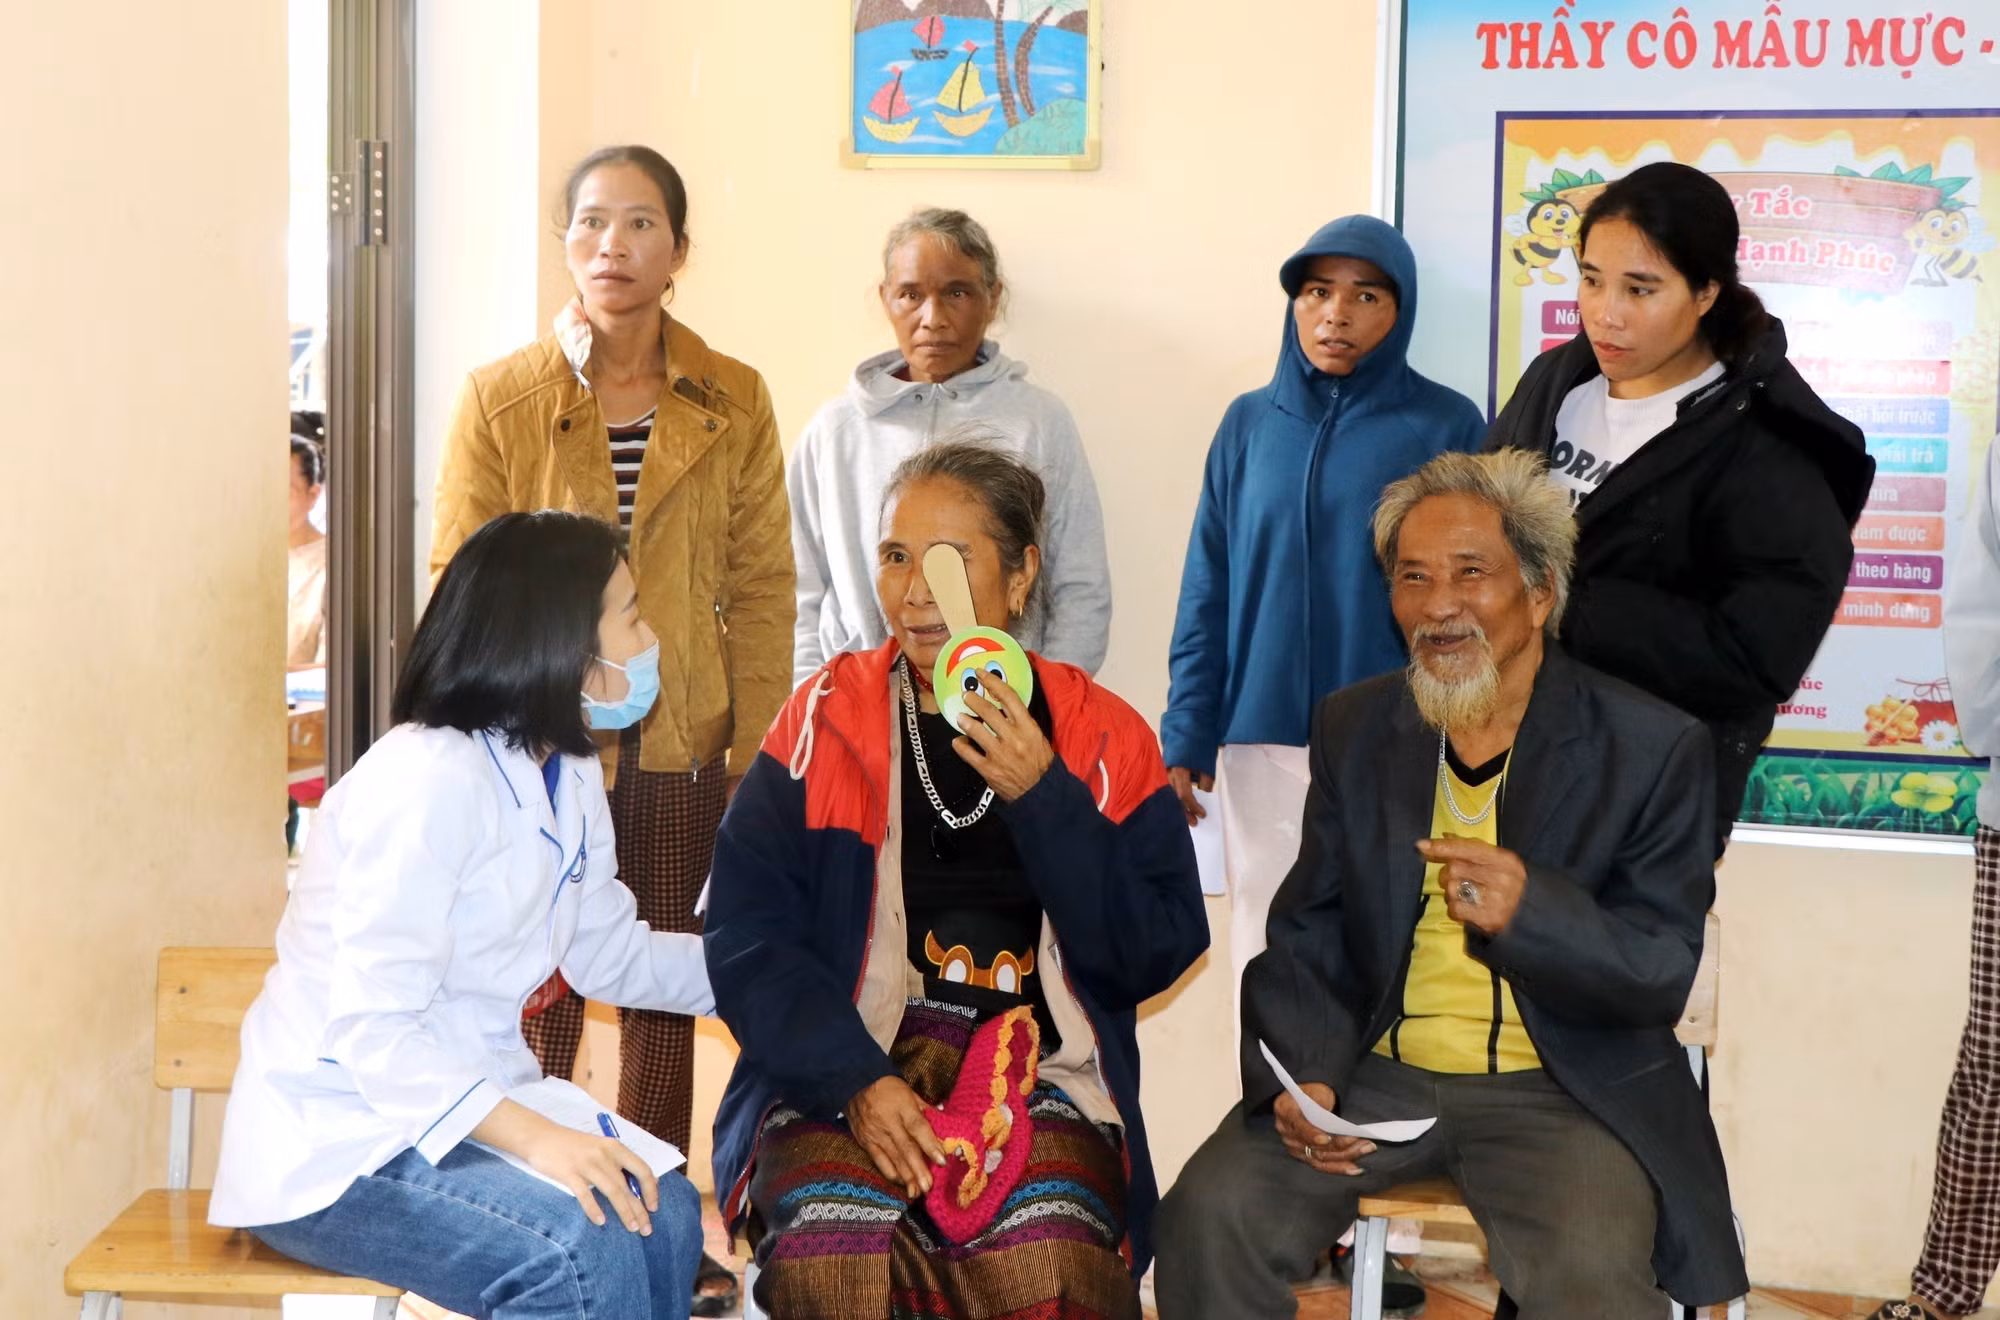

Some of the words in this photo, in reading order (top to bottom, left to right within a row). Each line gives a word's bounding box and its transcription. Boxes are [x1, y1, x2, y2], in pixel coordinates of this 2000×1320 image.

[1476, 0, 1616, 69] THẦY
[1626, 7, 1697, 69] CÔ
[1844, 12, 1966, 79] MỰC
[1750, 187, 1811, 216] Tắc
[1816, 241, 1895, 272] Phúc
[1555, 308, 1580, 325] Nói
[1855, 561, 1888, 578] theo
[1893, 562, 1932, 583] hàng
